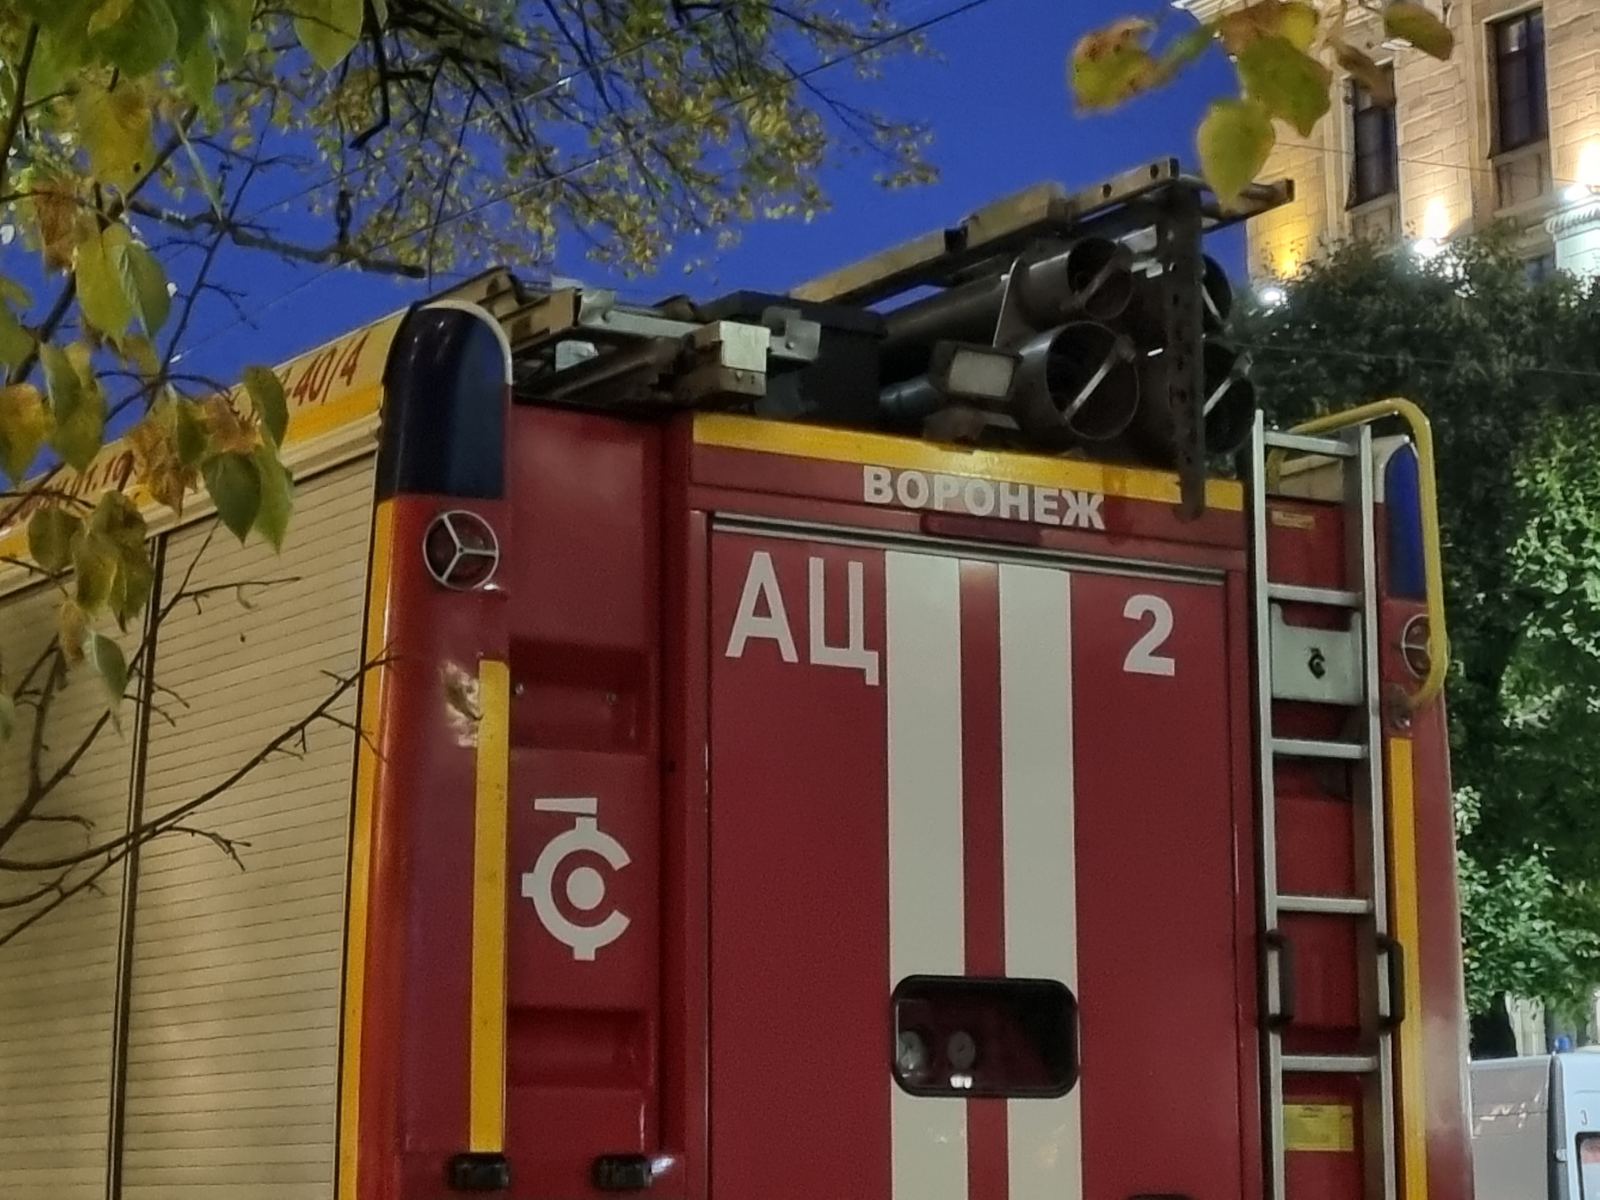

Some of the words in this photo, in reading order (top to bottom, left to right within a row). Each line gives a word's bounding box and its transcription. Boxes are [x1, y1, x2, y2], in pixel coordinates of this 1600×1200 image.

[863, 465, 1106, 530] ВОРОНЕЖ
[725, 550, 880, 686] АЦ
[1123, 594, 1175, 677] 2
